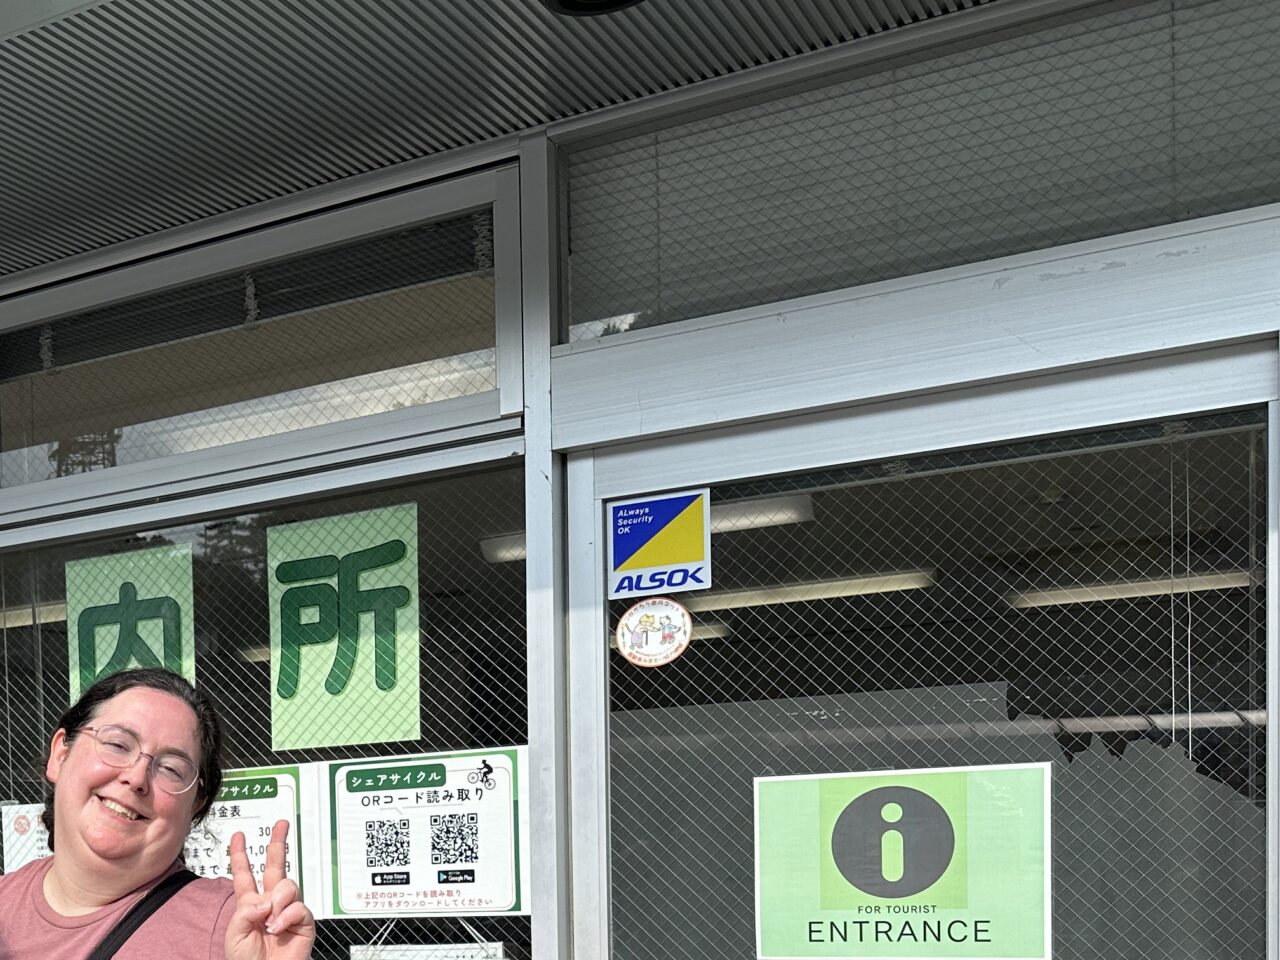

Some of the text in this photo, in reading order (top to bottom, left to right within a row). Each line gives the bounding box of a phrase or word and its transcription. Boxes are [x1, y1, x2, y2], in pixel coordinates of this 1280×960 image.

[618, 507, 650, 517] ALways
[617, 514, 654, 526] Security
[617, 526, 631, 534] OK
[614, 566, 705, 594] ALSOK
[351, 772, 442, 788] シェアサイクル
[364, 898, 493, 908] アプリをダウンロードしてください
[857, 904, 937, 915] FOR TOURIST
[808, 919, 992, 943] ENTRANCE
